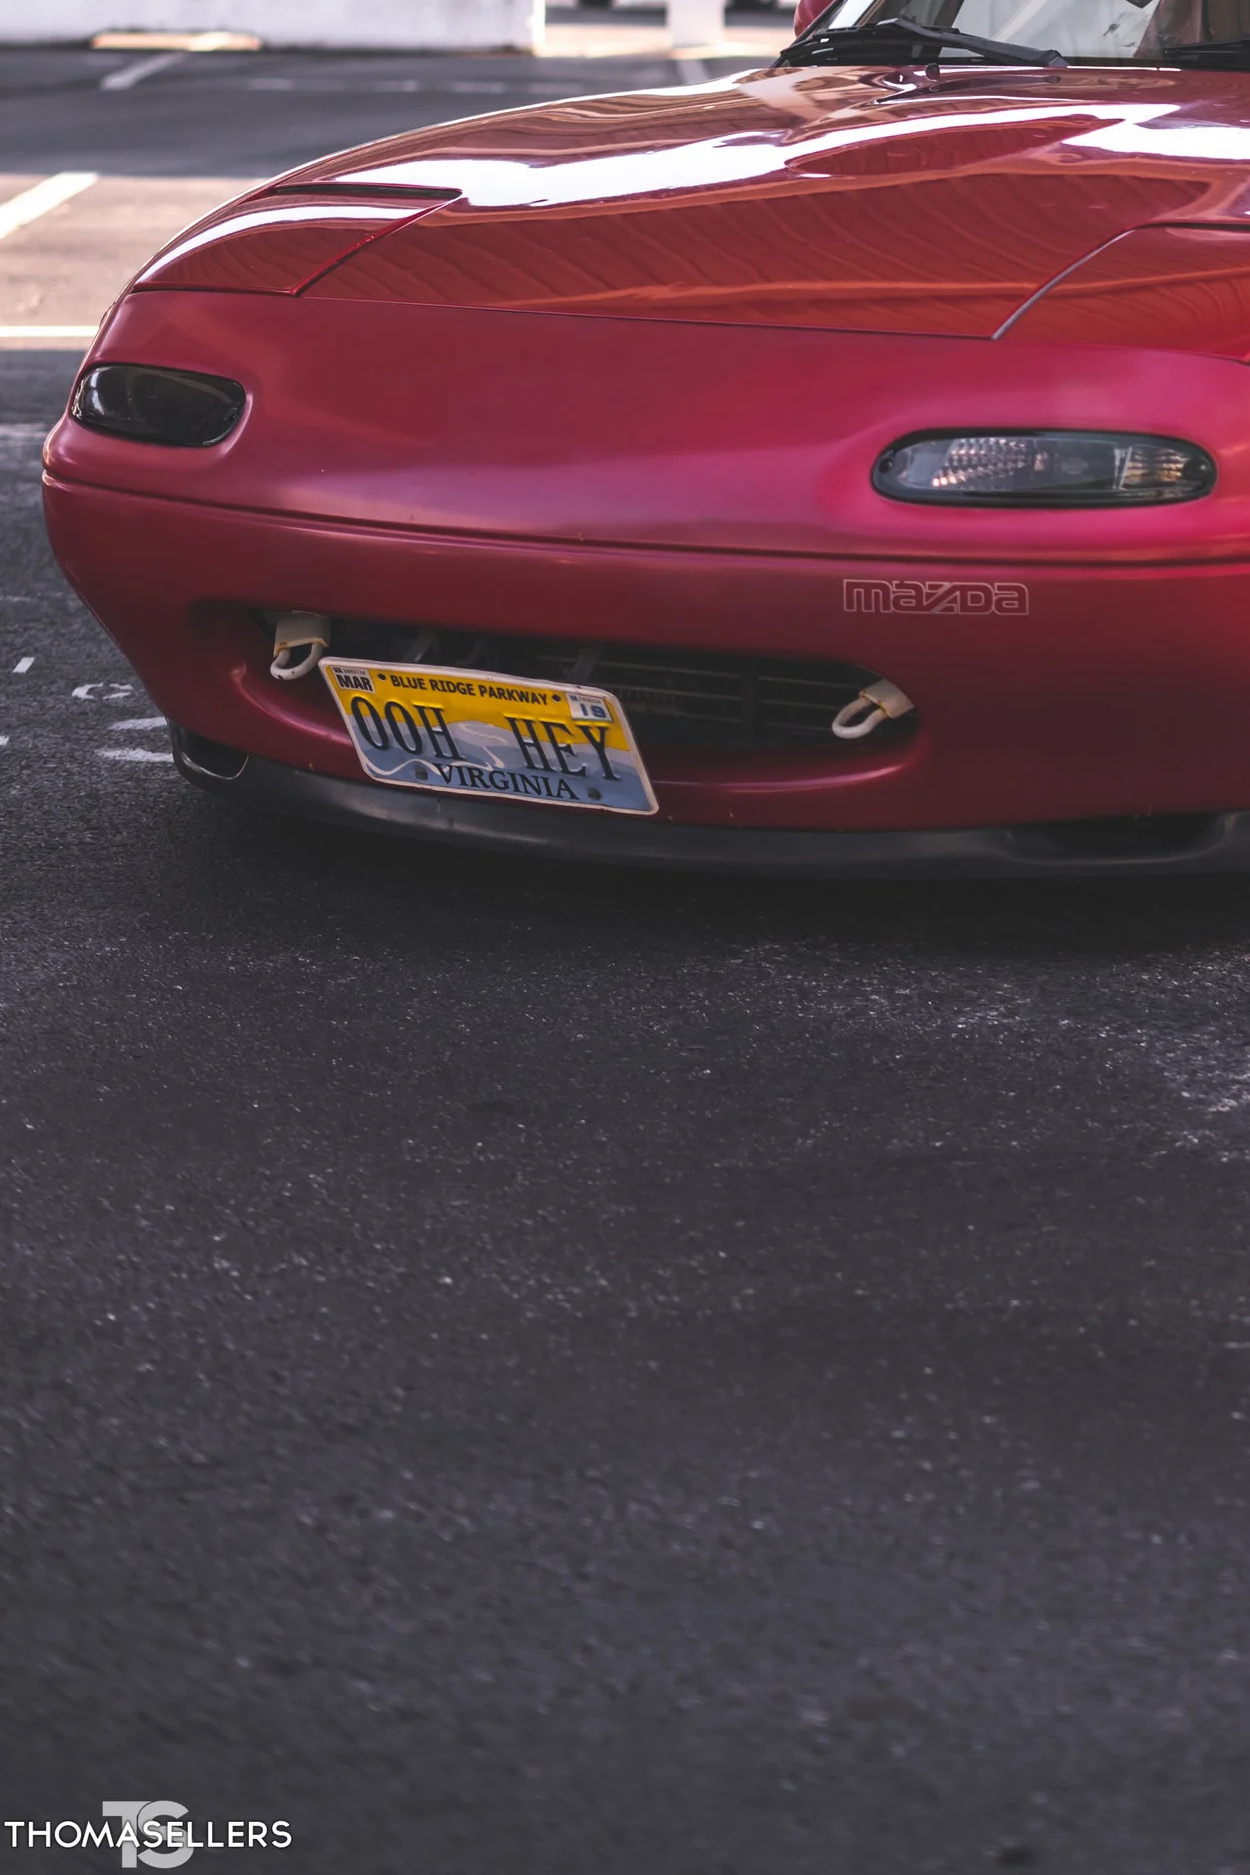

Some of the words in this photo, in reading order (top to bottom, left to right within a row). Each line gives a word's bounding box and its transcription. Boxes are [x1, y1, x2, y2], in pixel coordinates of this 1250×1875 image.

[336, 675, 374, 692] MAR
[390, 675, 428, 693] BLUE
[430, 680, 476, 697] RIDGE
[479, 685, 548, 706] PARKWAY
[350, 696, 466, 762] OOH
[504, 716, 622, 781] HEY
[434, 763, 580, 801] VIRGINIA
